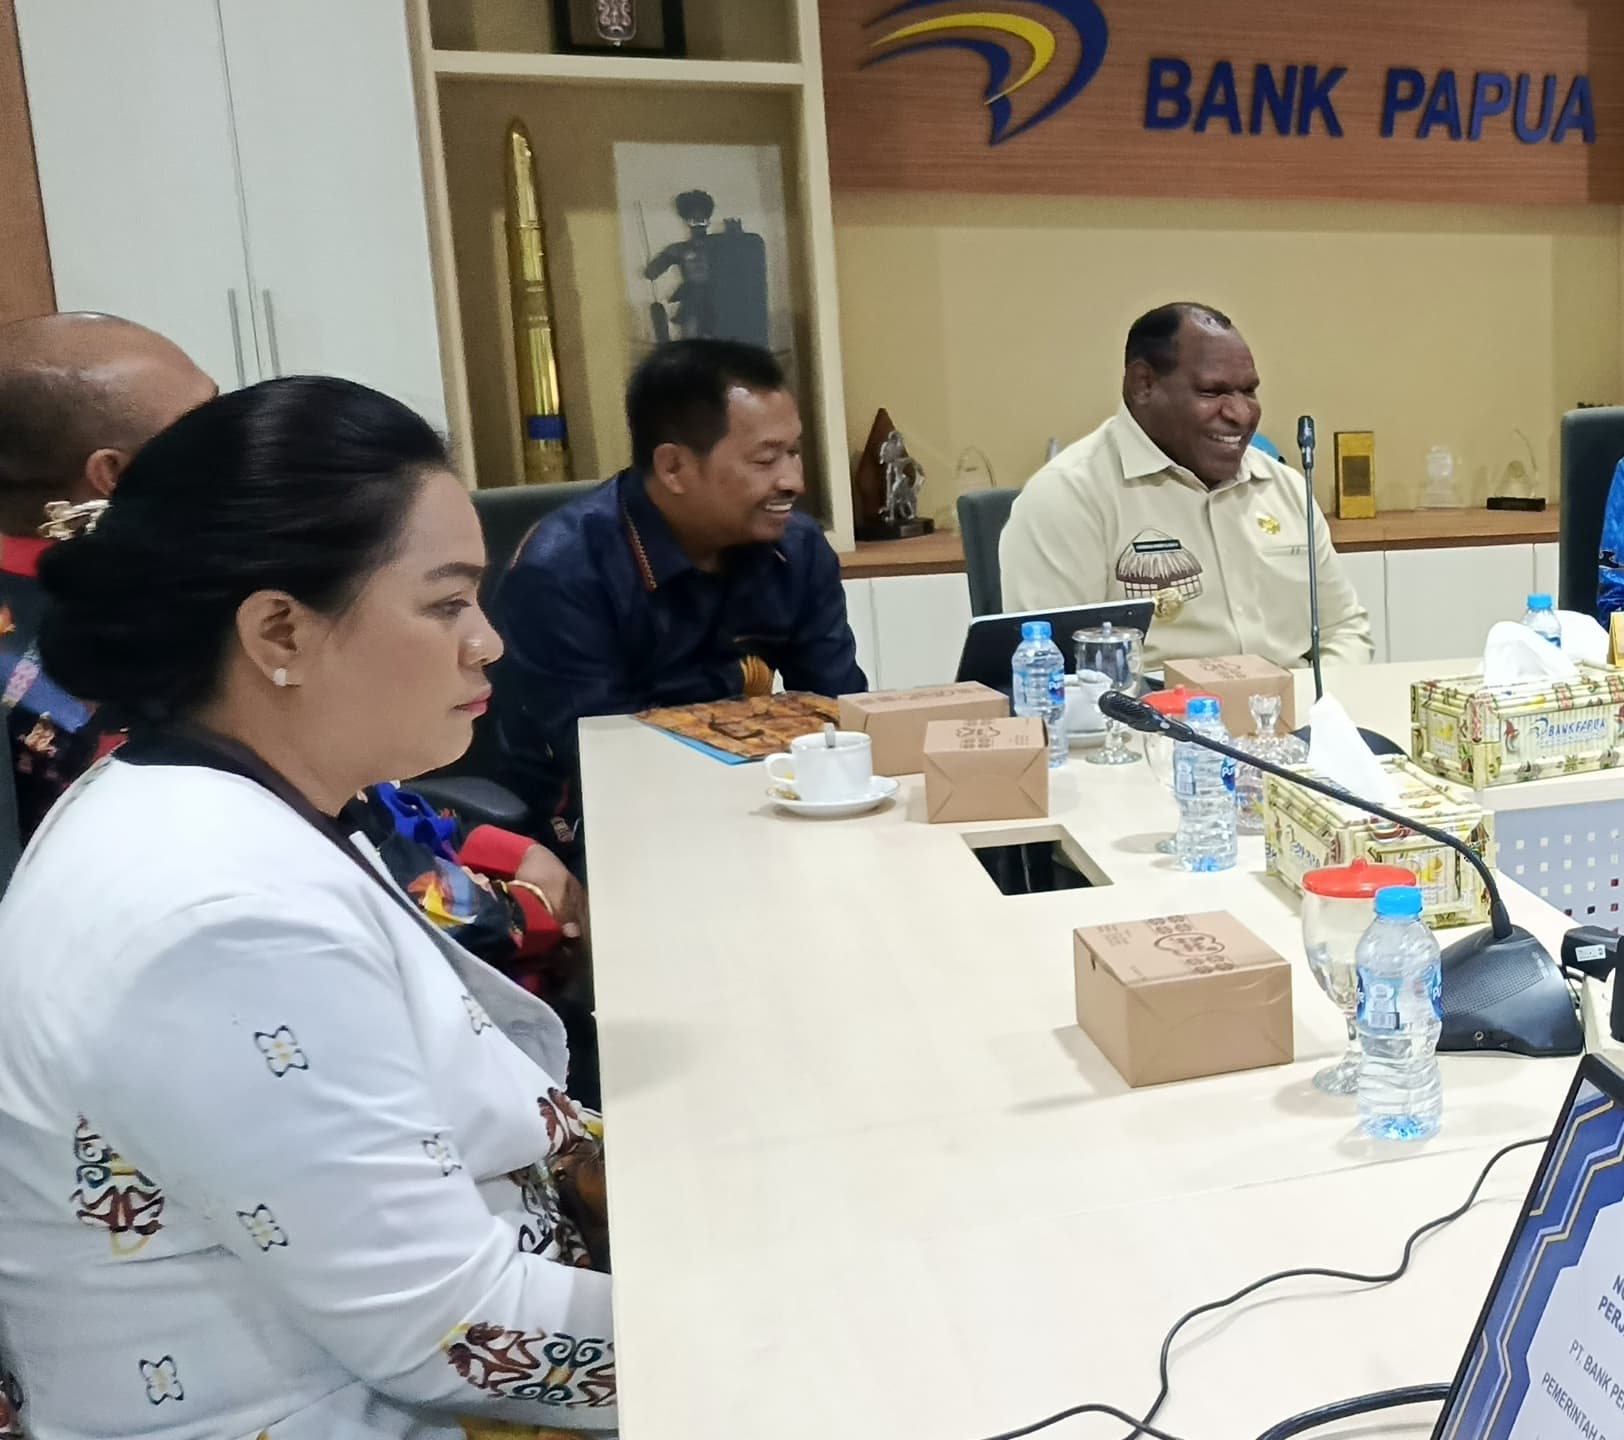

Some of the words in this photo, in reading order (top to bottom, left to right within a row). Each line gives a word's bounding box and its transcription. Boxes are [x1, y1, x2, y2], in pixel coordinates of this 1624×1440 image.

[1144, 57, 1347, 138] BANK
[1380, 67, 1597, 145] PAPUA
[1568, 1339, 1585, 1364] PT.
[1583, 1354, 1613, 1393] BANK
[1541, 1372, 1599, 1440] PEMERINTAH
